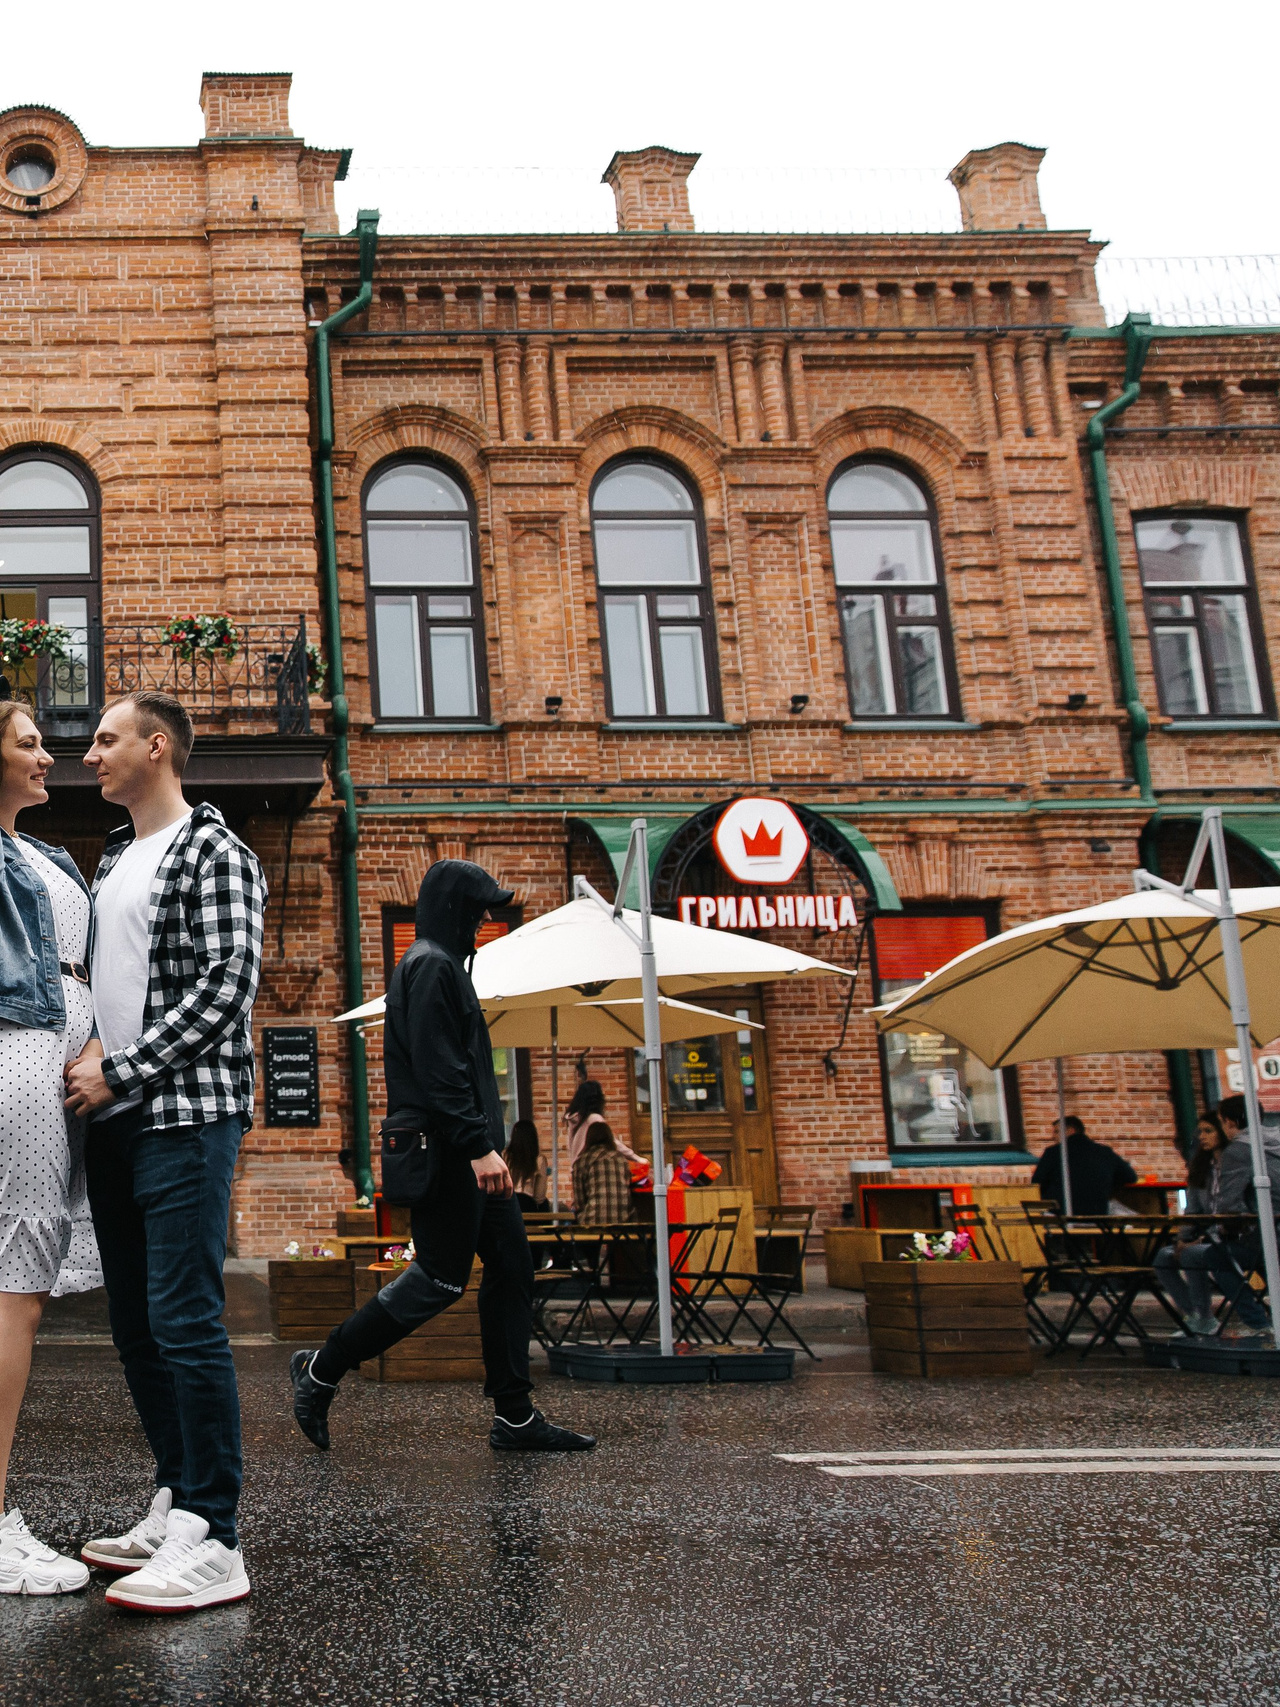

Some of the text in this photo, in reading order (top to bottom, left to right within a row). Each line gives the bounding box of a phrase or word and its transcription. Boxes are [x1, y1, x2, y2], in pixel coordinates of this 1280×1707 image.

[678, 895, 858, 932] ГРИЛЬНИЦА
[277, 1087, 308, 1097] sisters
[433, 1278, 462, 1293] Reebok
[175, 1515, 191, 1524] adidas
